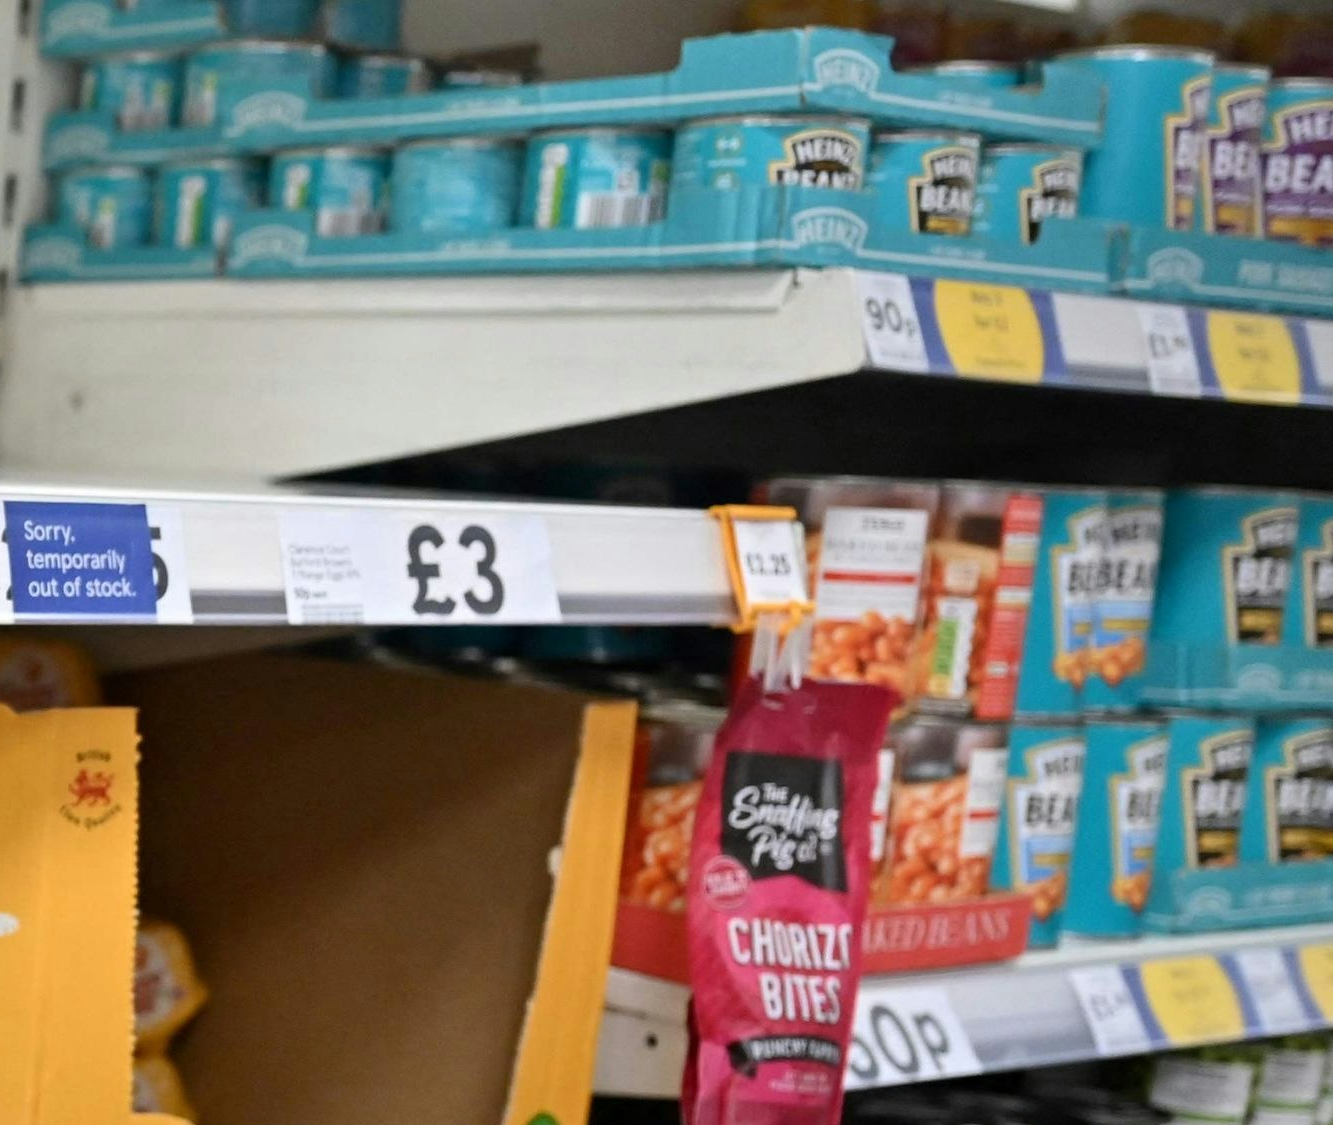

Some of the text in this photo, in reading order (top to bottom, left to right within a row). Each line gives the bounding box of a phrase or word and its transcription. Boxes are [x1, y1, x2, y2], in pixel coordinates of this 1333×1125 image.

[23, 520, 77, 545] Sorry,
[25, 548, 127, 575] temporarily
[407, 524, 506, 616] £3
[28, 574, 138, 599] out of stock.
[747, 824, 796, 871] Pig
[759, 971, 842, 1026] BITES
